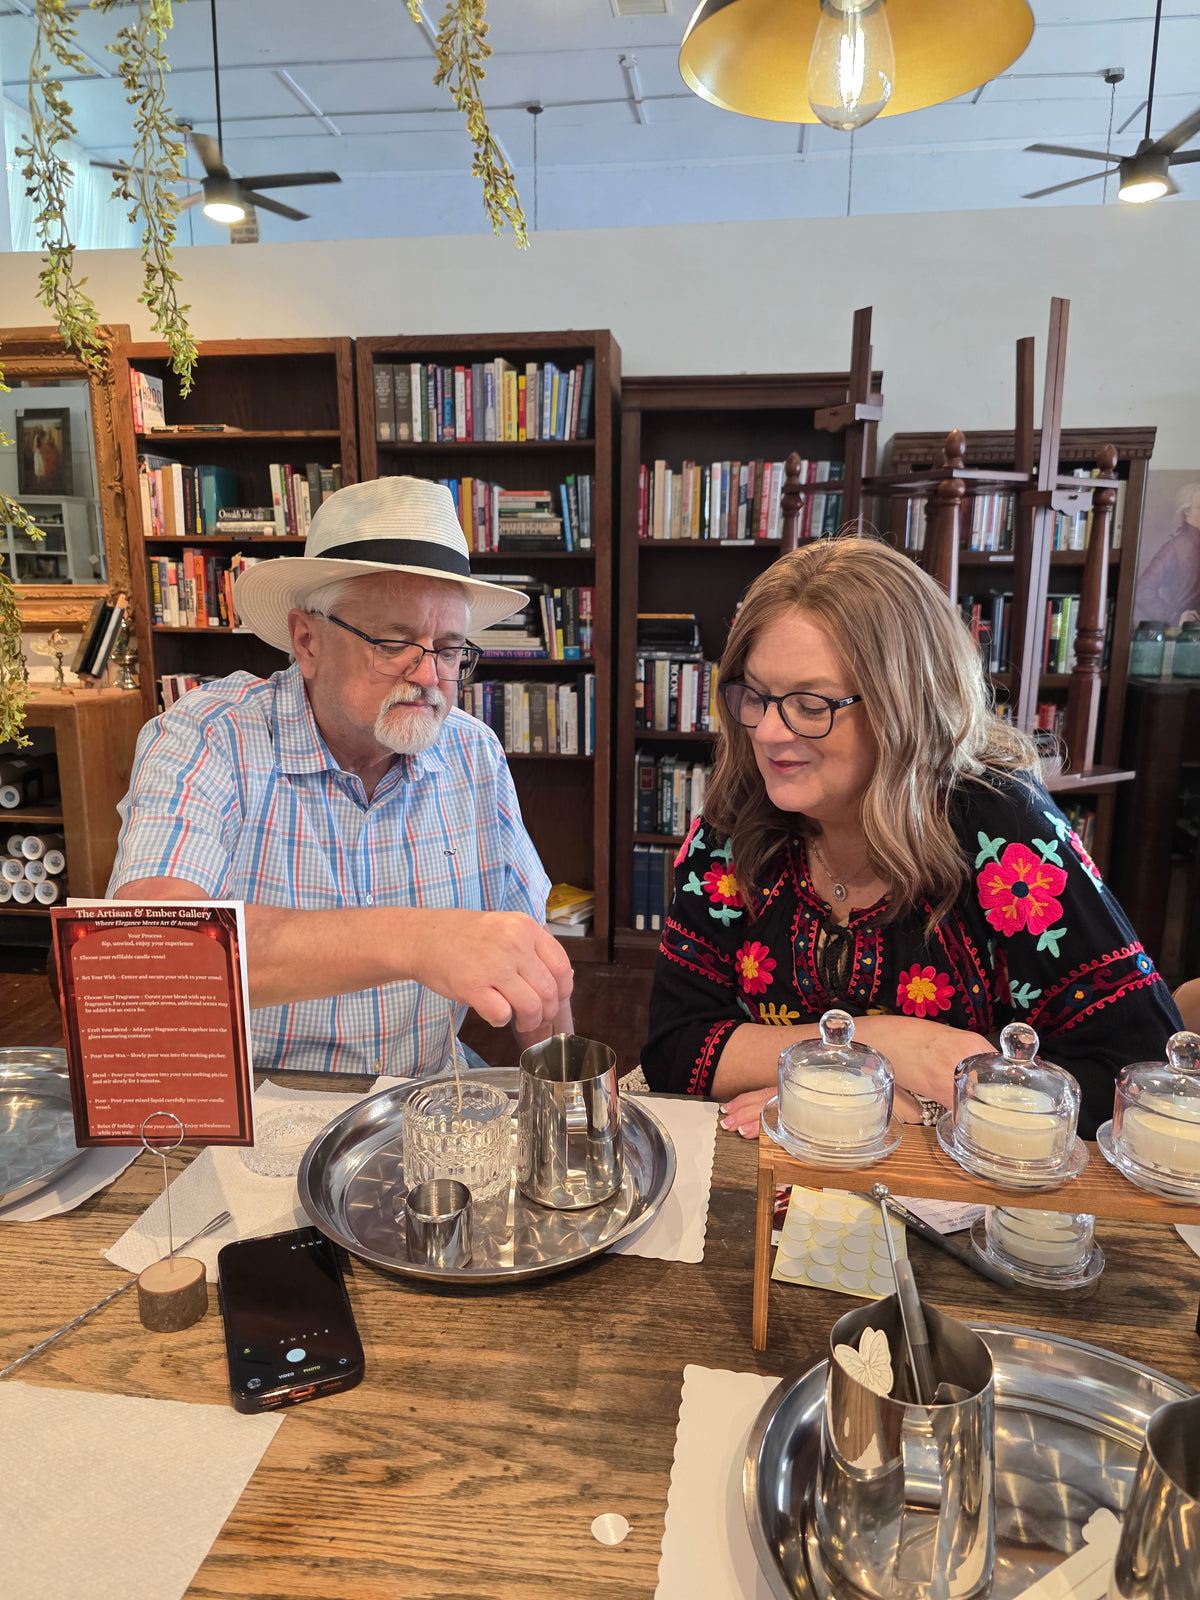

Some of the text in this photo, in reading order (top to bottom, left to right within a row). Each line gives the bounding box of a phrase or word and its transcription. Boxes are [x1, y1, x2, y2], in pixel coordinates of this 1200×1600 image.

[143, 386, 162, 404] HOOD
[241, 508, 252, 518] Tale
[76, 908, 212, 920] The Artisan & Ember Gallery
[891, 1206, 909, 1217] Round
